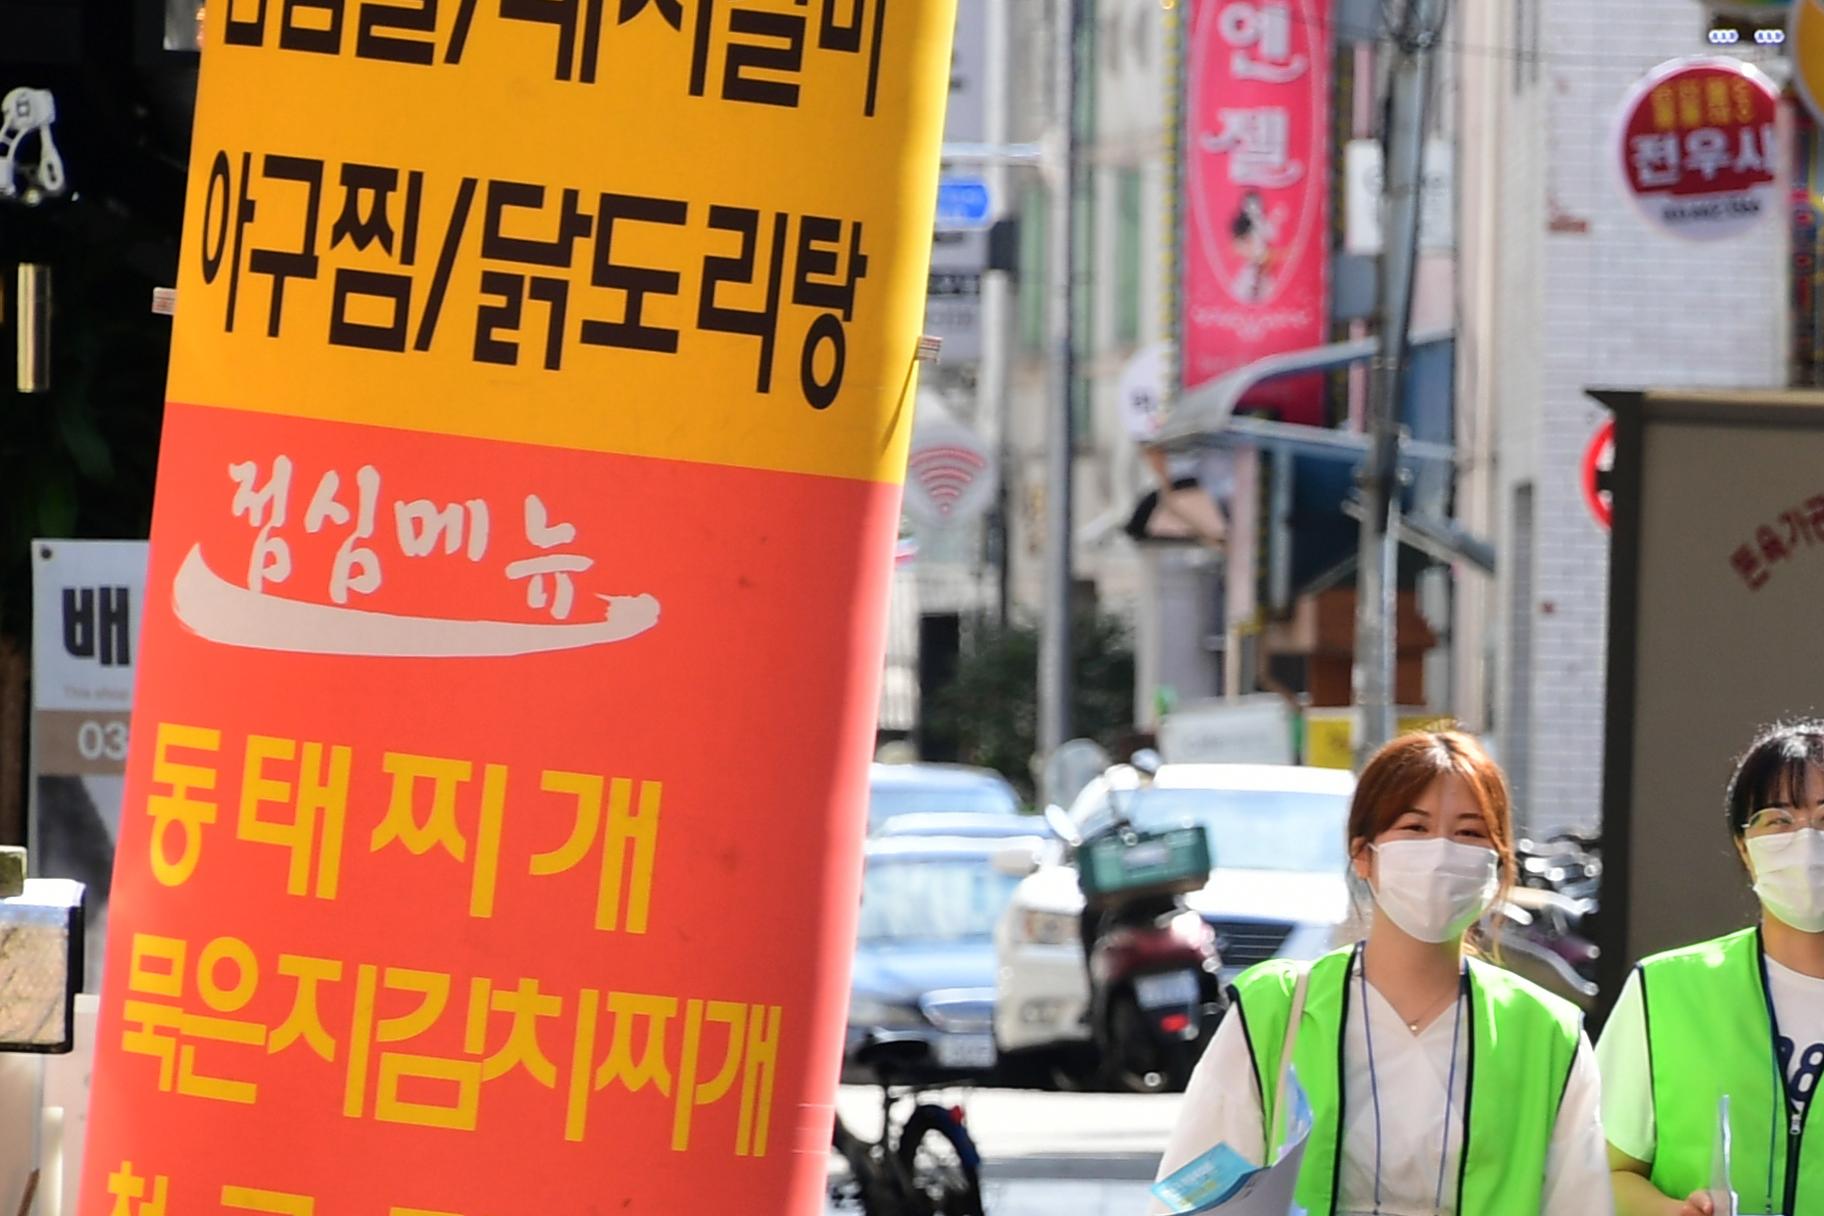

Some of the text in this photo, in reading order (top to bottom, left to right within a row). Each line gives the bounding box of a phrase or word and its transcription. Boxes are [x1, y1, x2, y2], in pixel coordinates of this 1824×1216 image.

[202, 150, 868, 410] 아구찜/닭도리탕
[226, 455, 595, 620] 점심메뉴
[146, 722, 663, 934] 동태찌개
[121, 933, 782, 1157] 묵은지김치찌개
